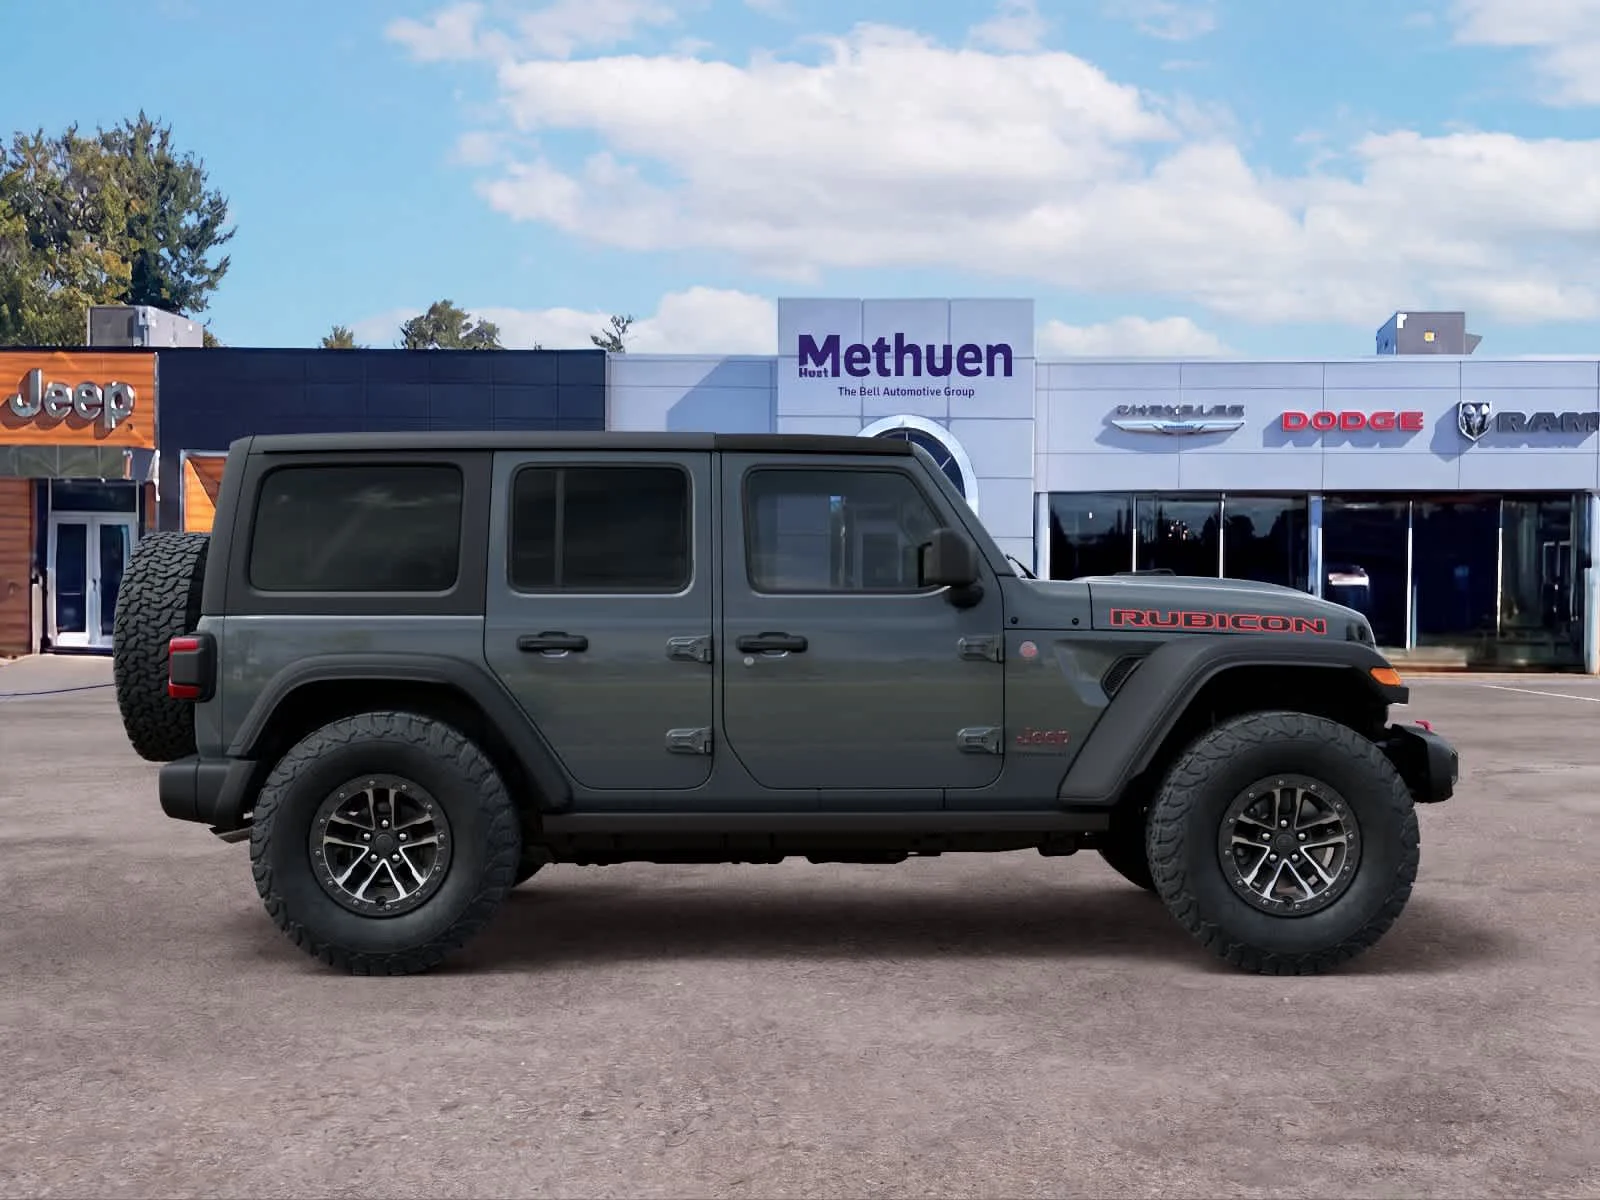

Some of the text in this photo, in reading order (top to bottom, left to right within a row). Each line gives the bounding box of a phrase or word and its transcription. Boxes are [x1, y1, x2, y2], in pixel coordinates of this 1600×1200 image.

[798, 333, 1013, 377] Methuen
[9, 368, 135, 431] Jeep
[838, 387, 975, 399] The Bell Automotive Group
[1281, 411, 1424, 432] DODGE
[1497, 411, 1600, 433] RAM
[1110, 608, 1327, 635] RUBICON
